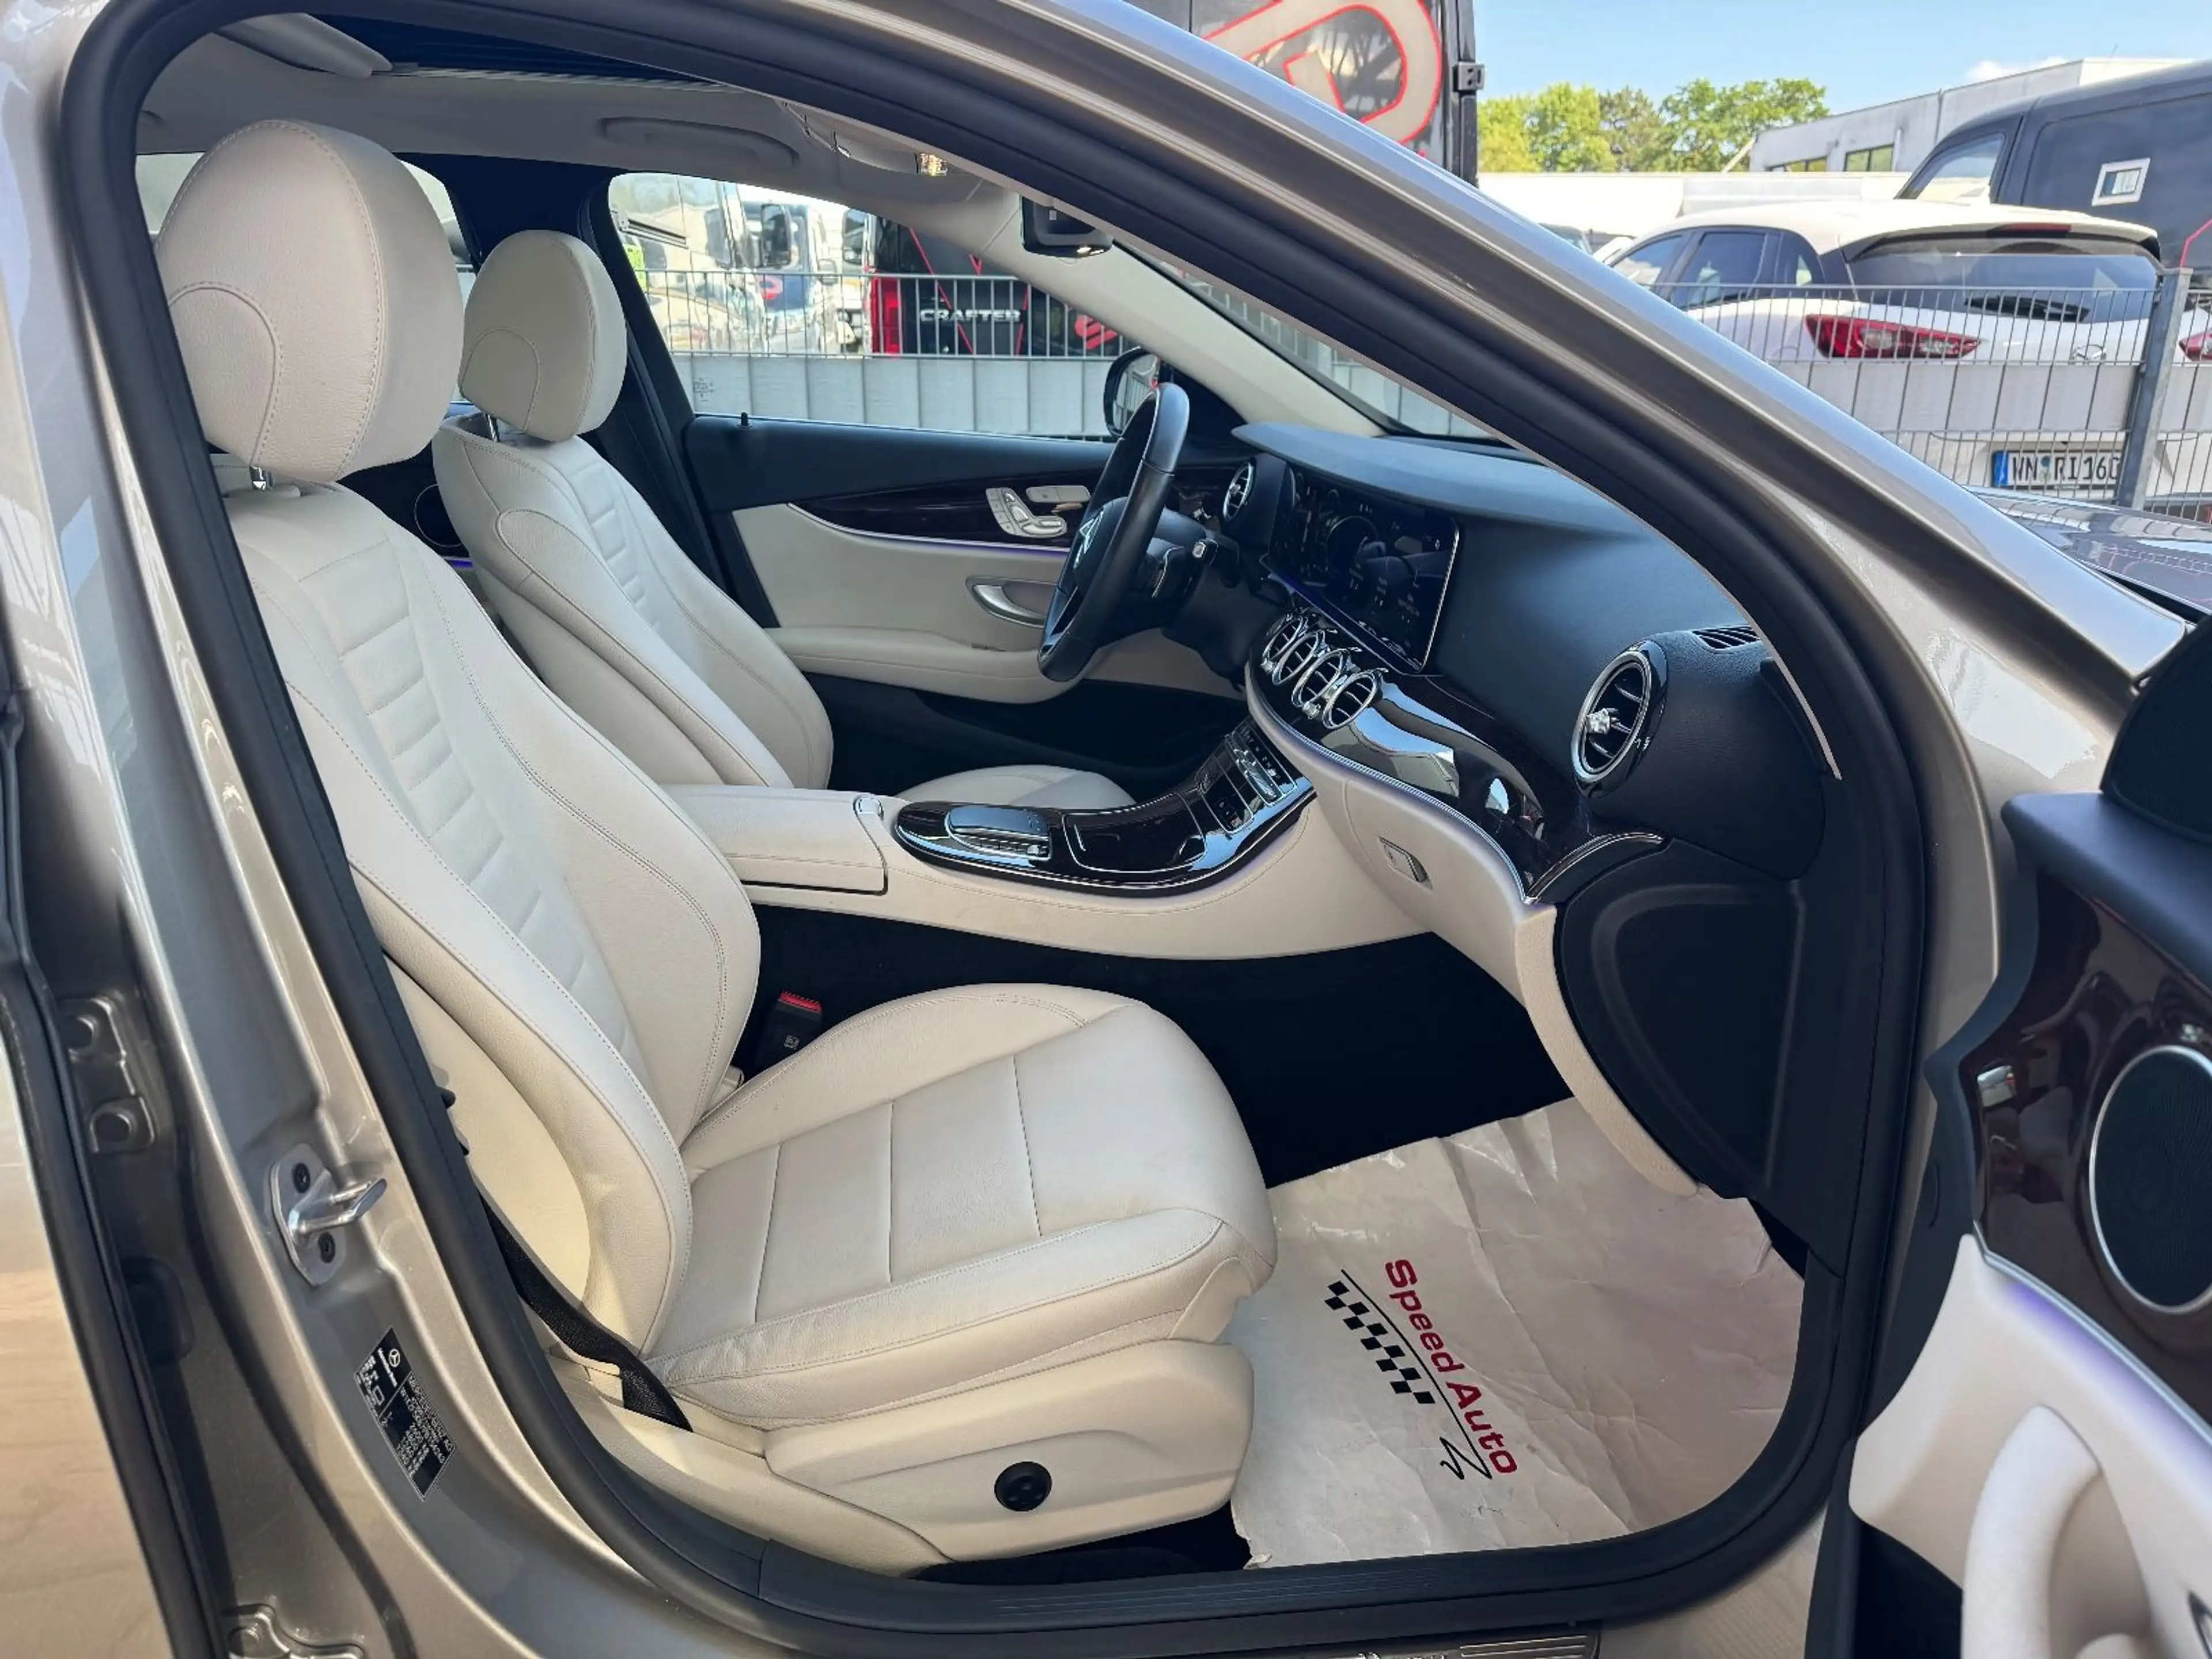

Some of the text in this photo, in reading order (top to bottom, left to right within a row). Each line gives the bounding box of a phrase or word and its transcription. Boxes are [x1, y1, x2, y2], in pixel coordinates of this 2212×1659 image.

[920, 309, 1021, 322] CRAFTER
[1385, 1259, 1518, 1474] Speed Auto
